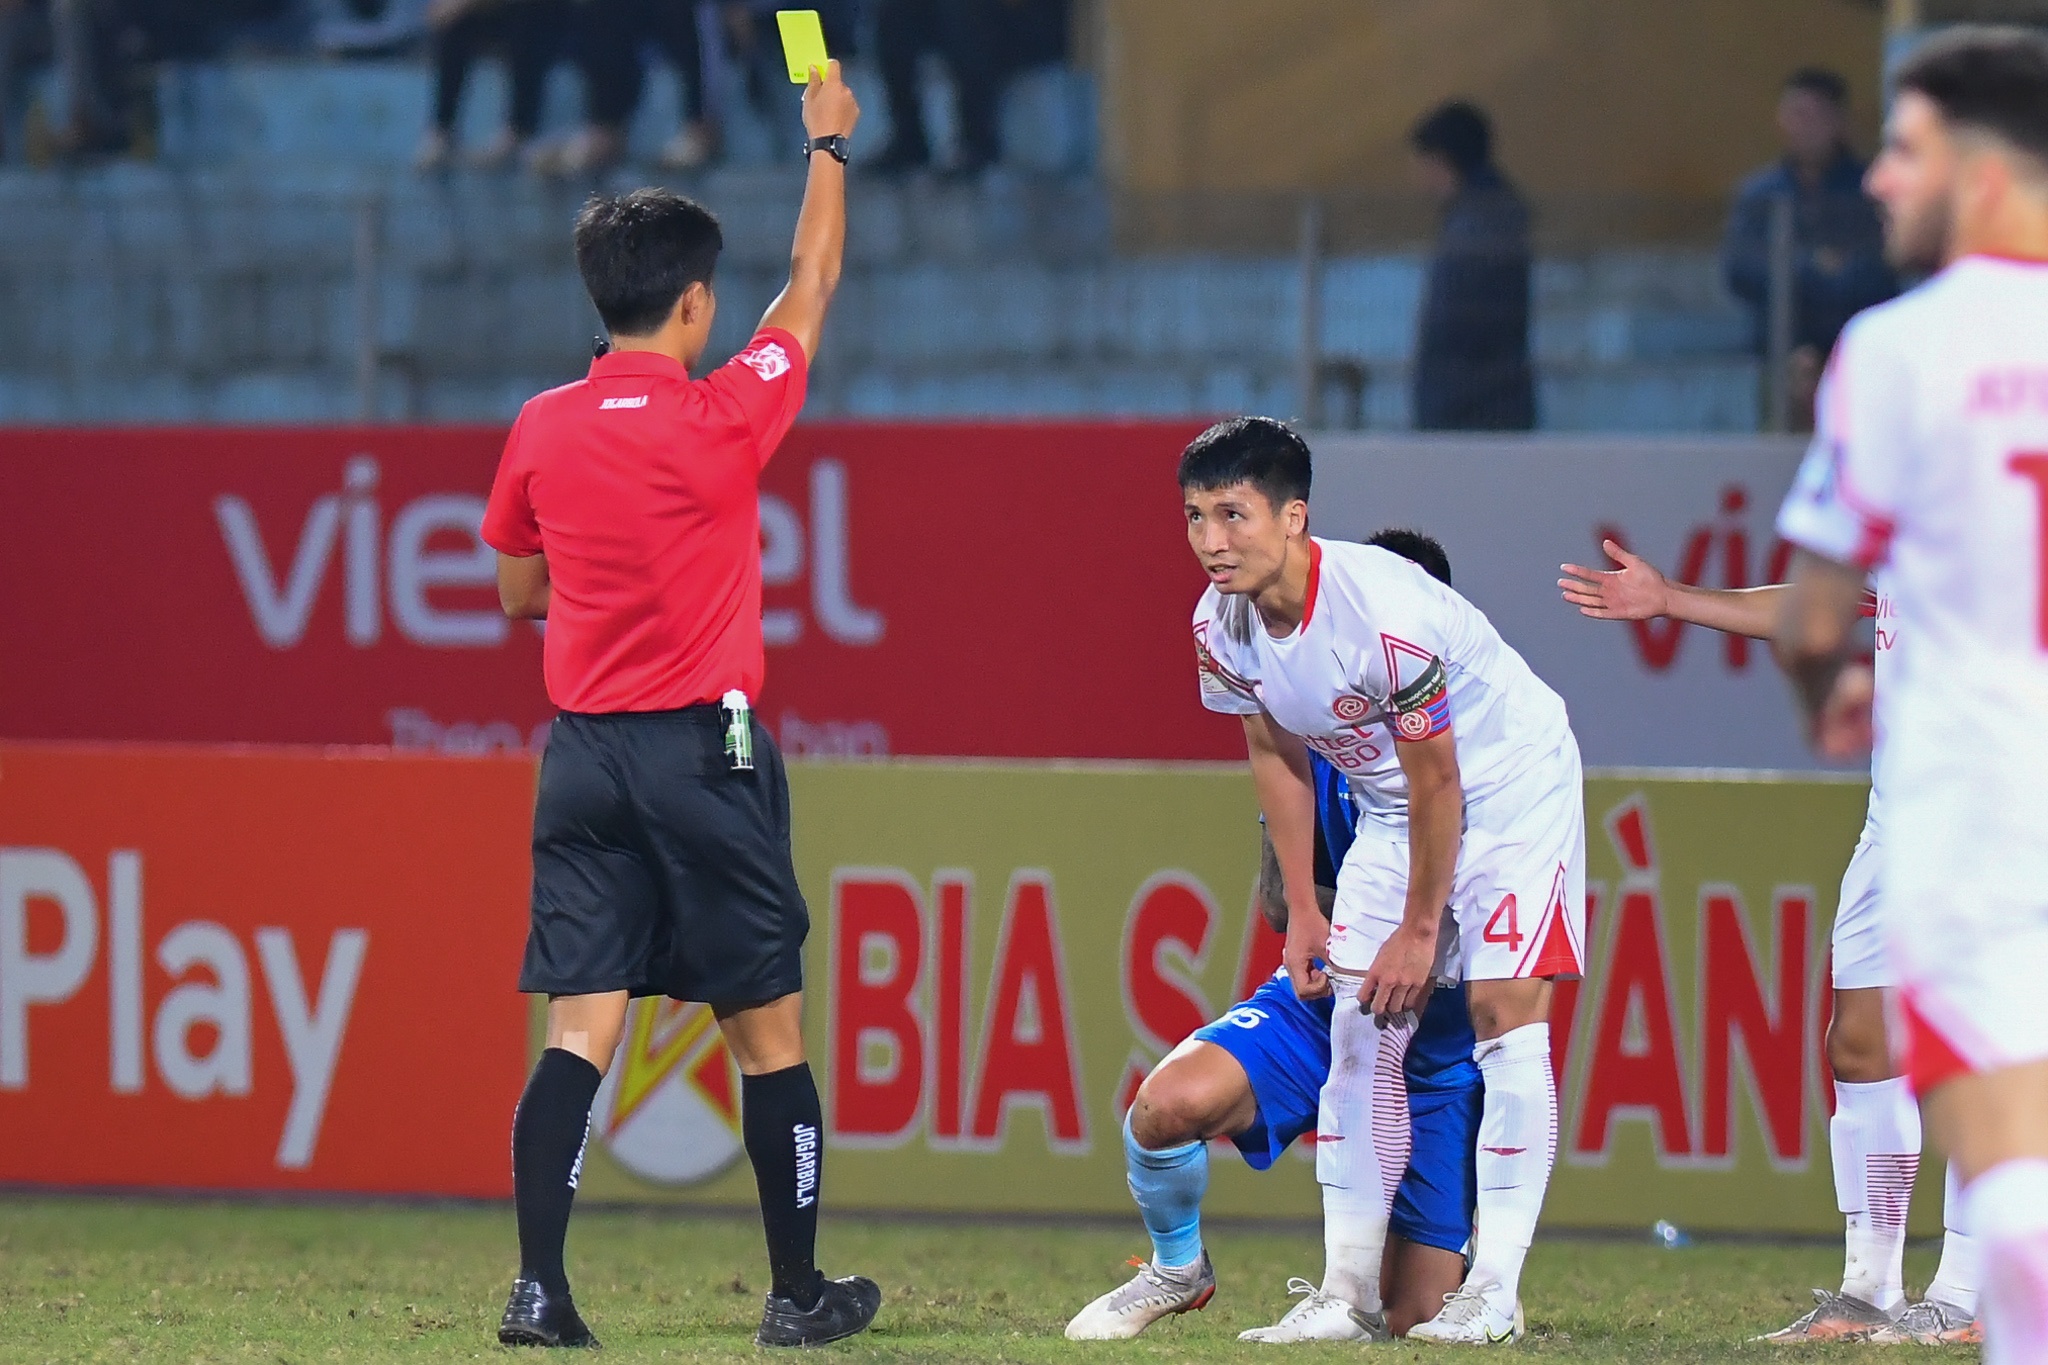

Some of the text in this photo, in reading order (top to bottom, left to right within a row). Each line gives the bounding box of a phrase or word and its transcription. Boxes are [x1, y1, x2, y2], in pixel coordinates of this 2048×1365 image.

[1876, 626, 1898, 651] tv
[1482, 893, 1524, 952] 4
[0, 846, 369, 1170] Play
[829, 868, 1090, 1153] BIA
[793, 1123, 816, 1208] JOGARBOLA
